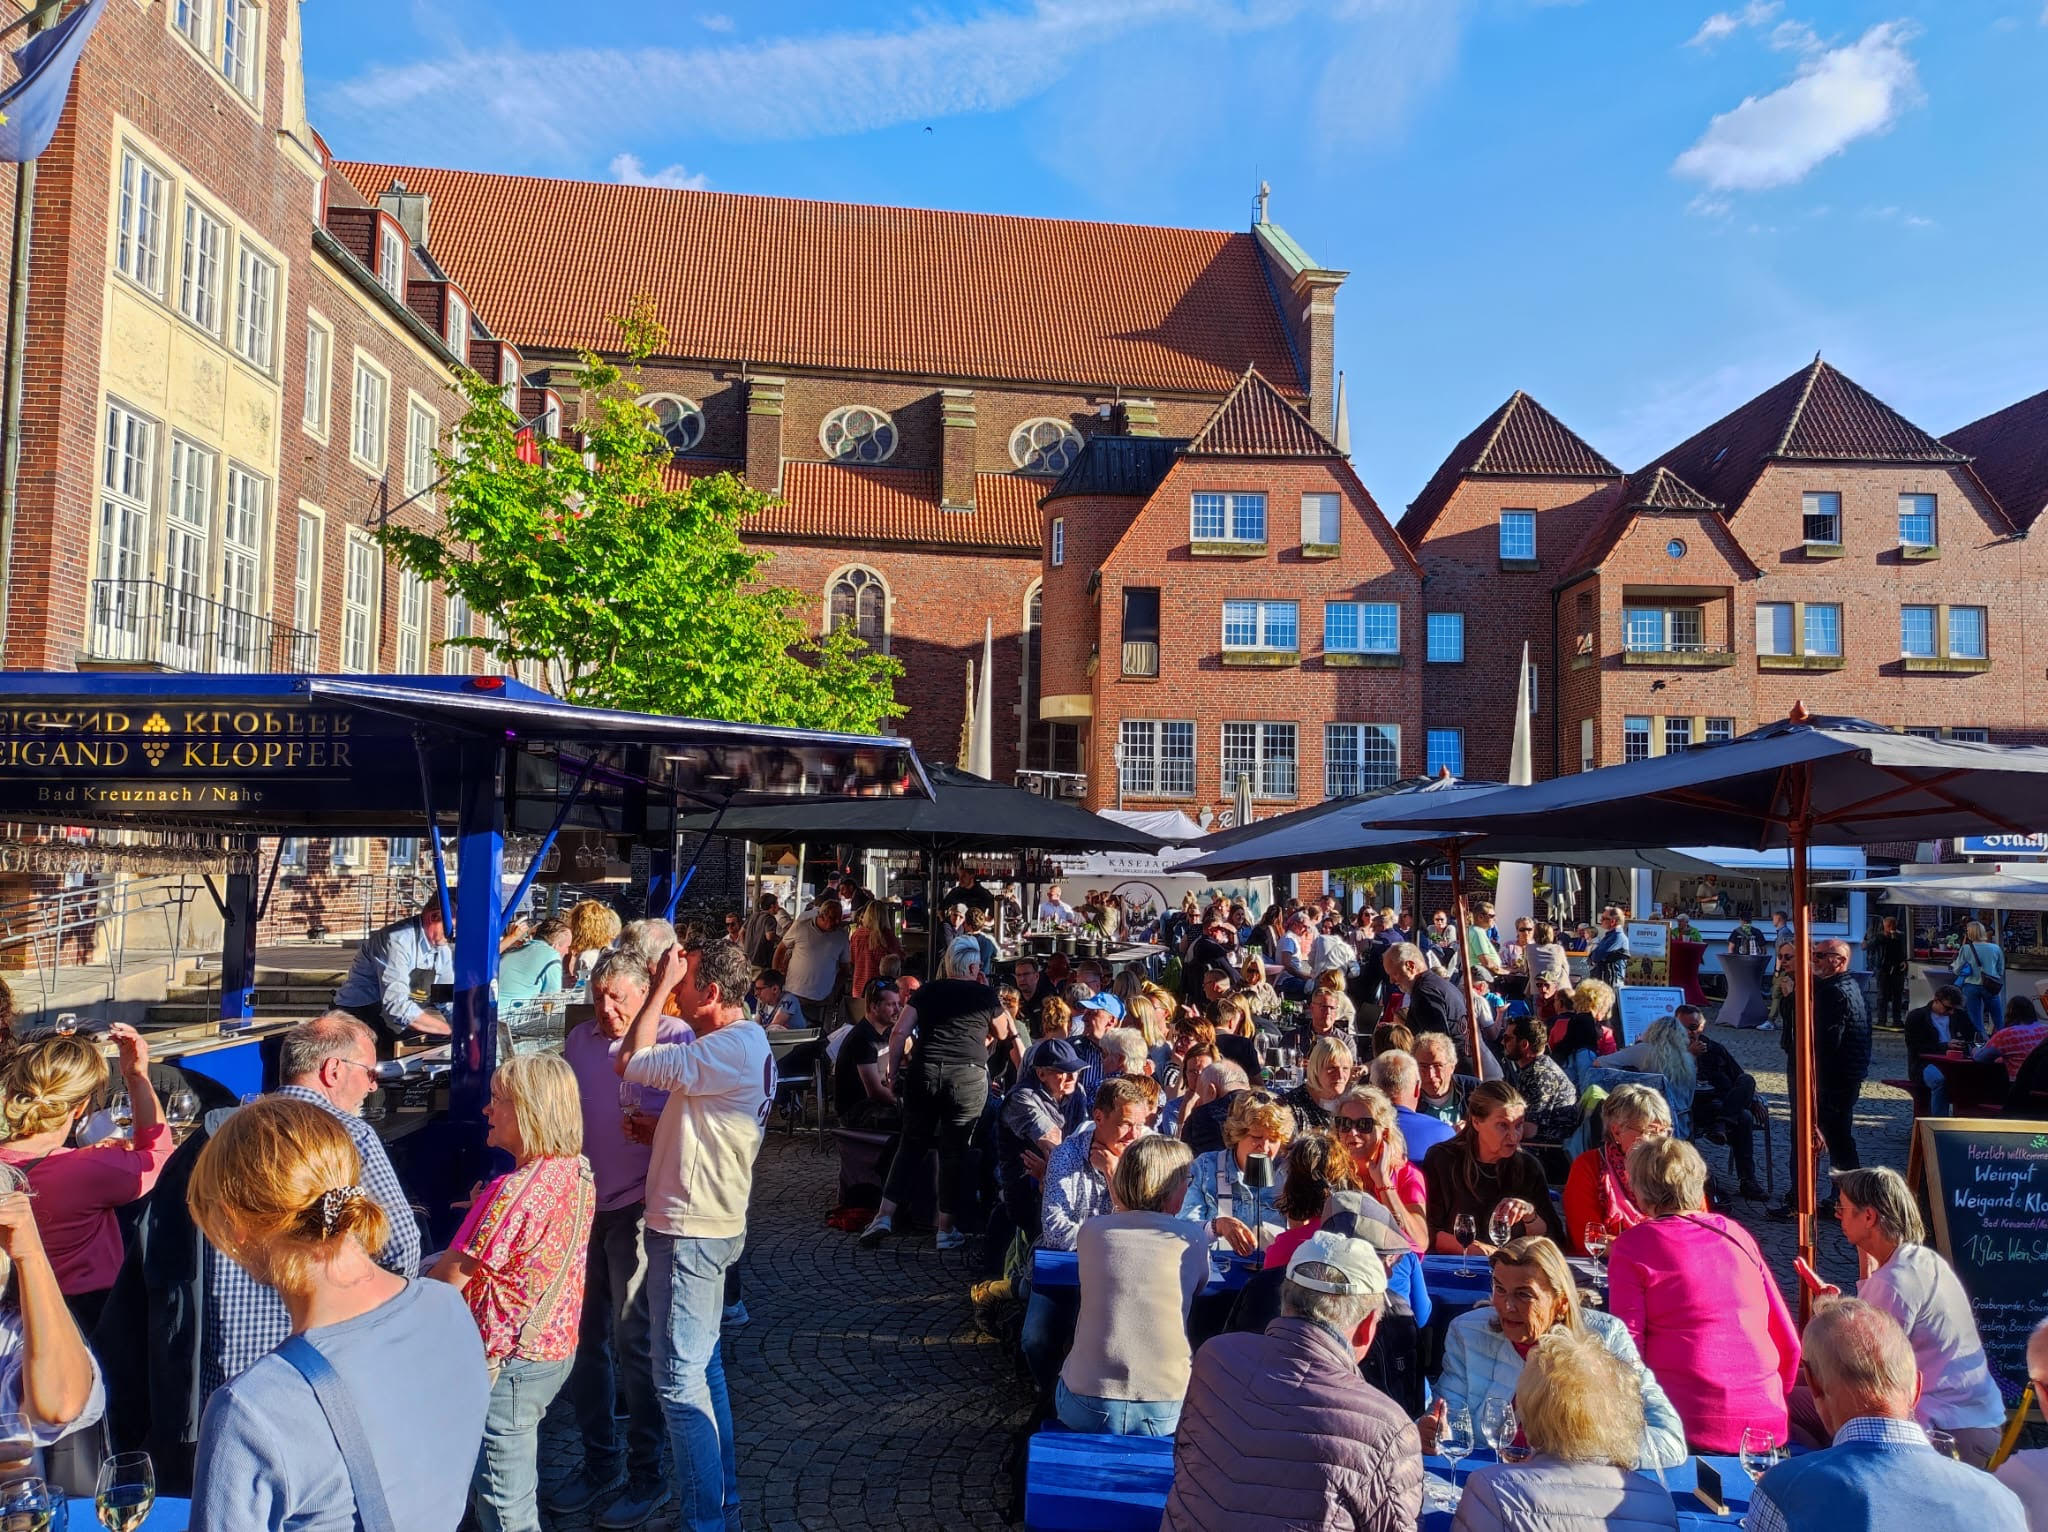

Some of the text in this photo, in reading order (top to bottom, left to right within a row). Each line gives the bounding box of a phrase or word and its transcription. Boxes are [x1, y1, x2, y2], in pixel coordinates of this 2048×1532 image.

[182, 741, 353, 768] KLOPFER
[38, 786, 75, 802] Bad
[83, 786, 193, 802] Kreuznach
[212, 786, 263, 802] Nahe
[1968, 1143, 2005, 1160] Herzlich
[1975, 1162, 2038, 1191] Weingut
[1954, 1188, 2014, 1217] Weigand
